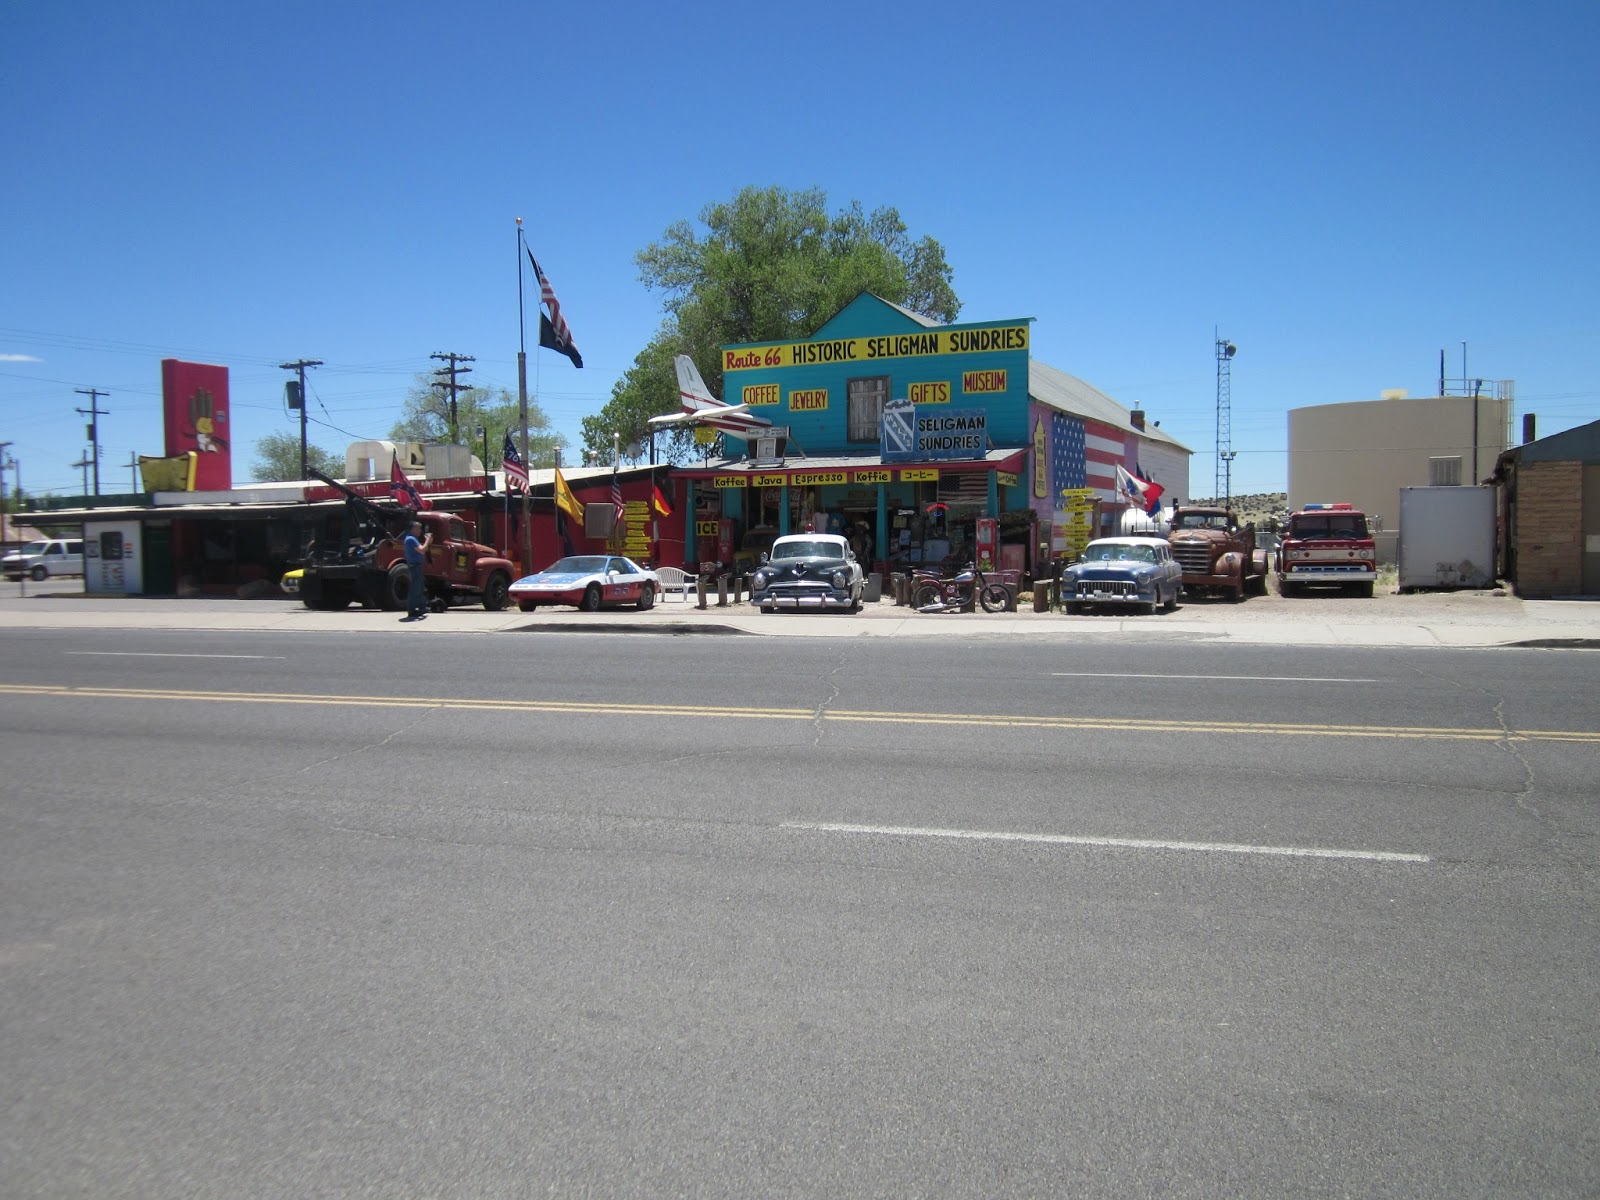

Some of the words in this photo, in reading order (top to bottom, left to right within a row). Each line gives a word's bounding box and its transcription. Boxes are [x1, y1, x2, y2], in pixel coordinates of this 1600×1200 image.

[726, 351, 761, 370] Route
[764, 347, 782, 366] 66
[792, 341, 857, 364] HISTORIC
[867, 334, 939, 358] SELIGMAN
[949, 328, 1026, 352] SUNDRIES
[963, 371, 1006, 392] MUSEUM
[743, 385, 778, 405] COFFEE
[790, 390, 827, 410] JEWELRY
[910, 383, 947, 403] GIFTS
[885, 414, 911, 447] MALTS
[918, 416, 985, 432] SELIGMAN
[918, 435, 981, 451] SUNDRIES
[507, 450, 519, 462] 76
[715, 477, 745, 487] Kaffee
[757, 475, 783, 486] Java
[795, 472, 843, 485] Espresso
[856, 472, 888, 482] Koffie
[904, 470, 934, 480] コーヒー
[697, 521, 718, 535] ICE
